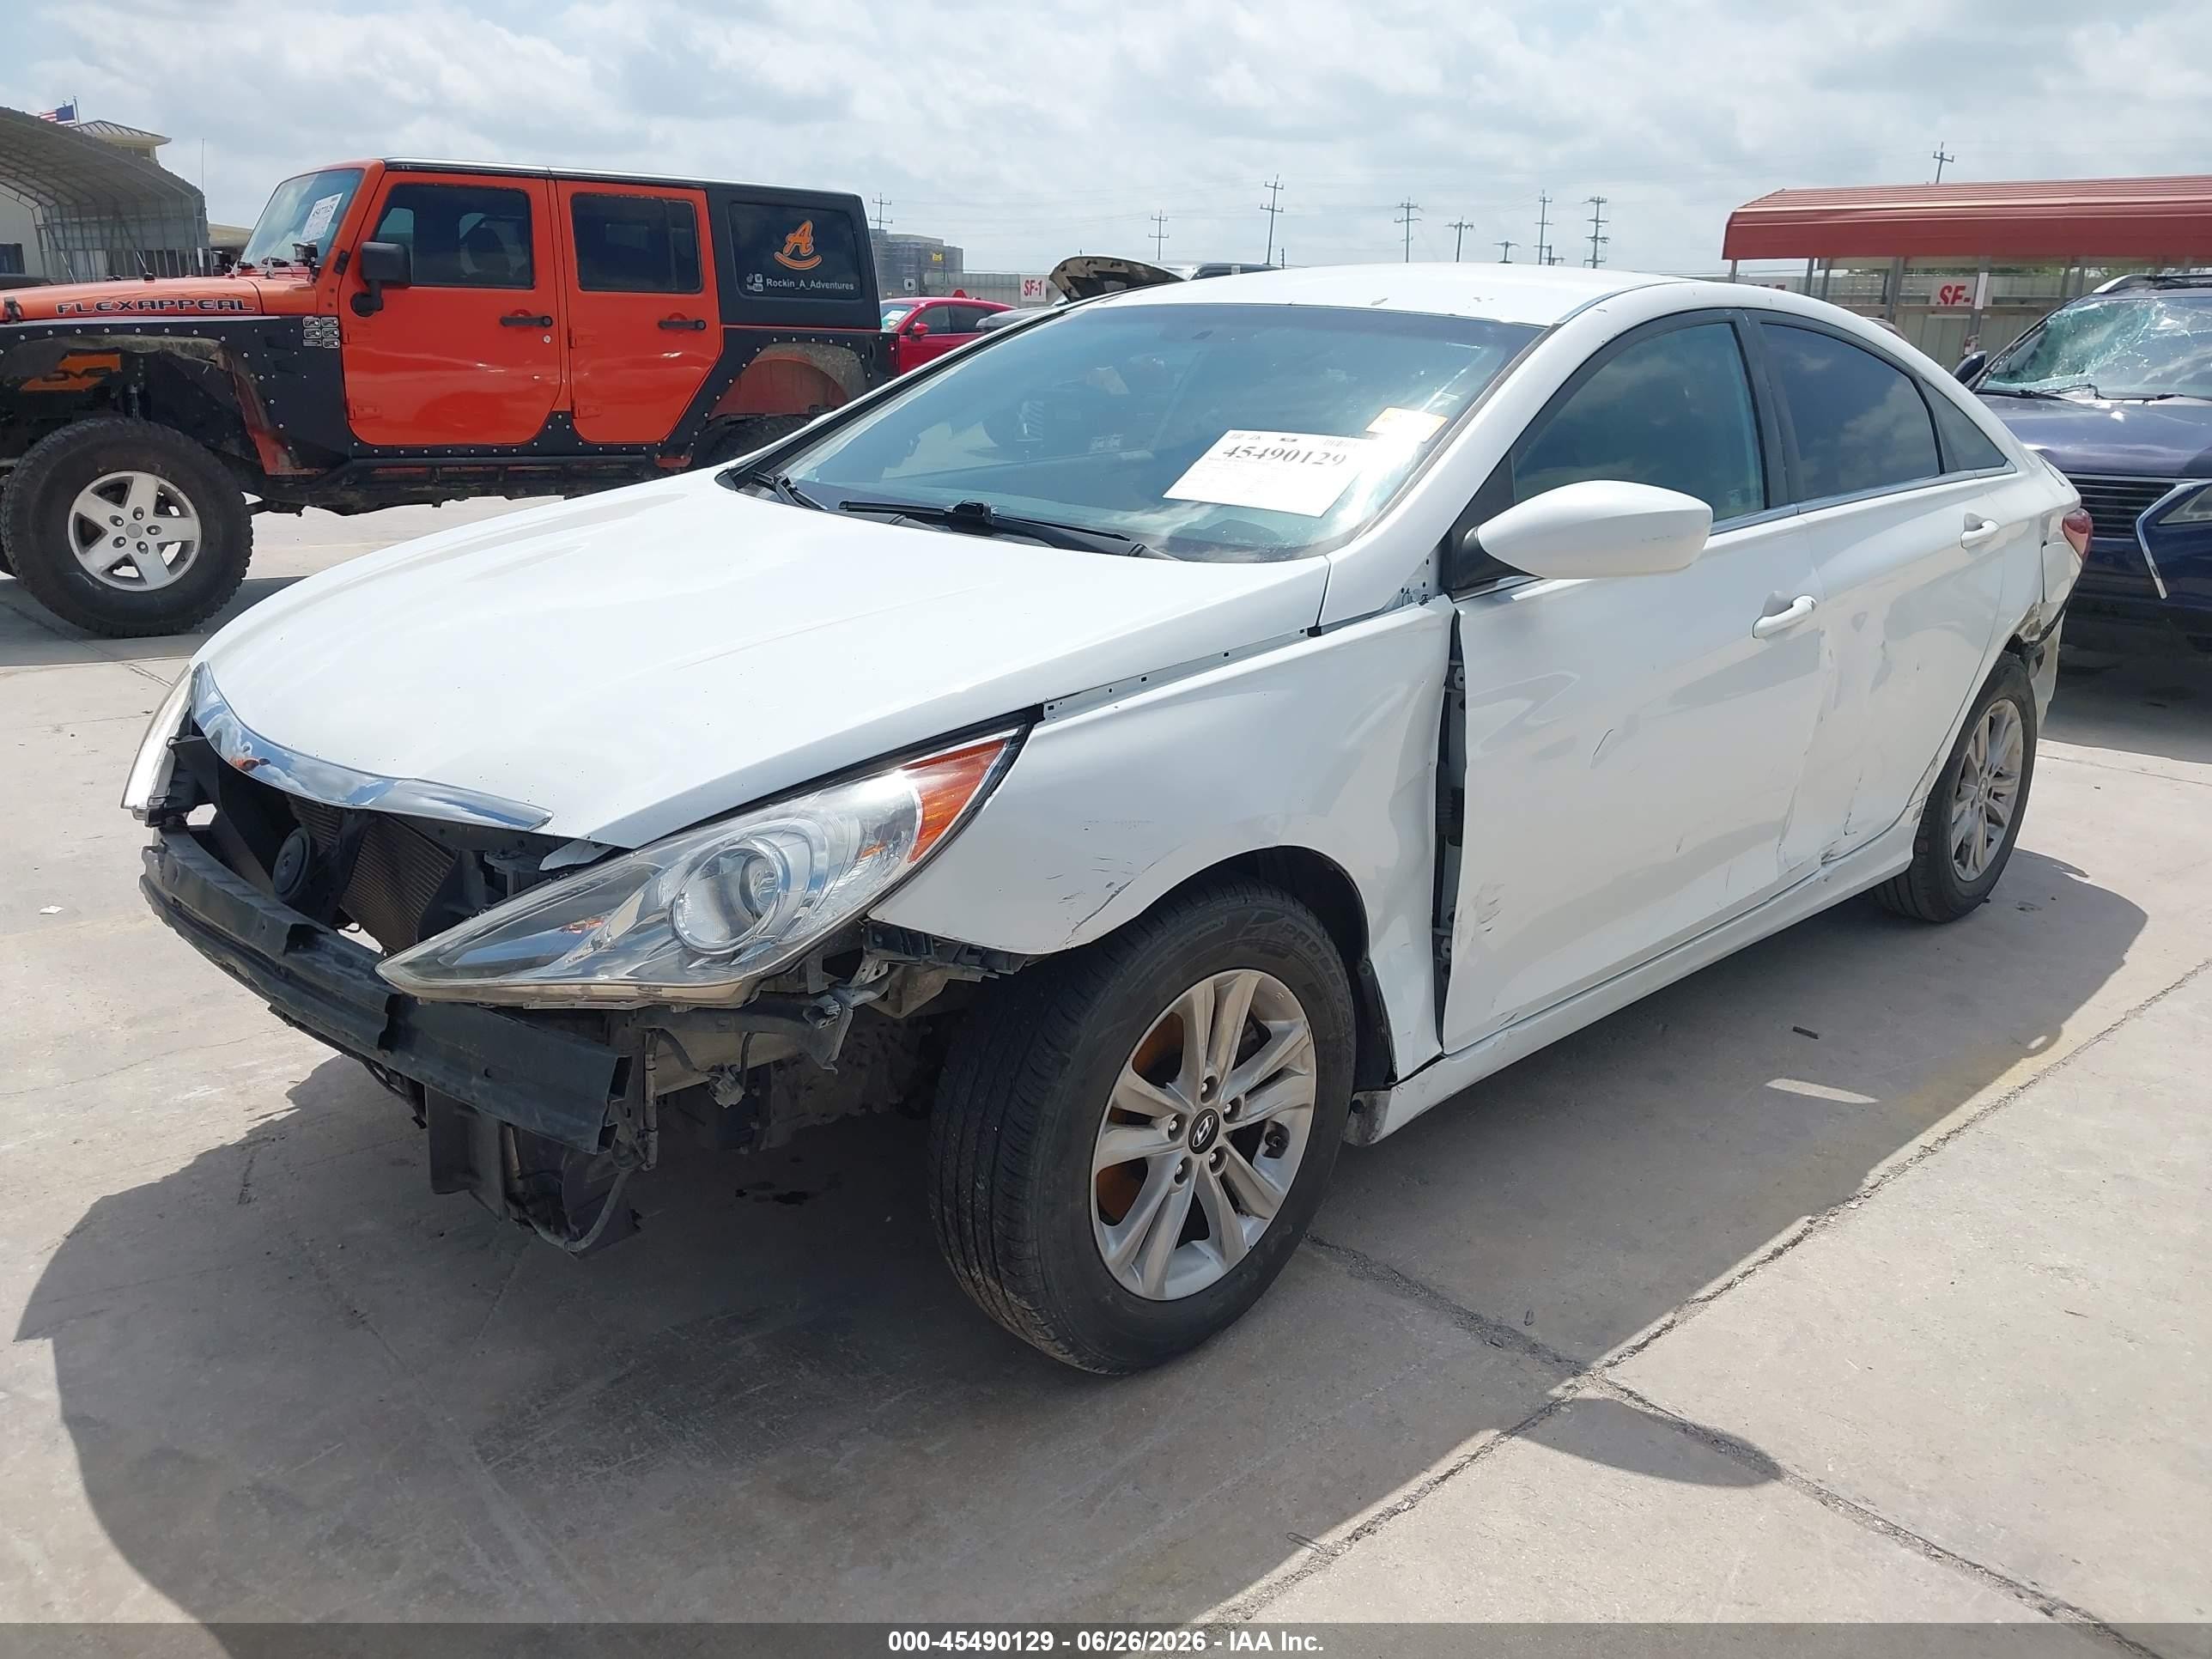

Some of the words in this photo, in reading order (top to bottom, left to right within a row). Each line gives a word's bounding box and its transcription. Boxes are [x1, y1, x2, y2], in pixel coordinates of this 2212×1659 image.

[766, 277, 854, 290] Rockin_A_Adventures
[1024, 279, 1042, 296] SF-1
[1937, 284, 1975, 305] SF-
[55, 298, 256, 315] FLEXAPPEAL
[1223, 445, 1346, 465] 45490129
